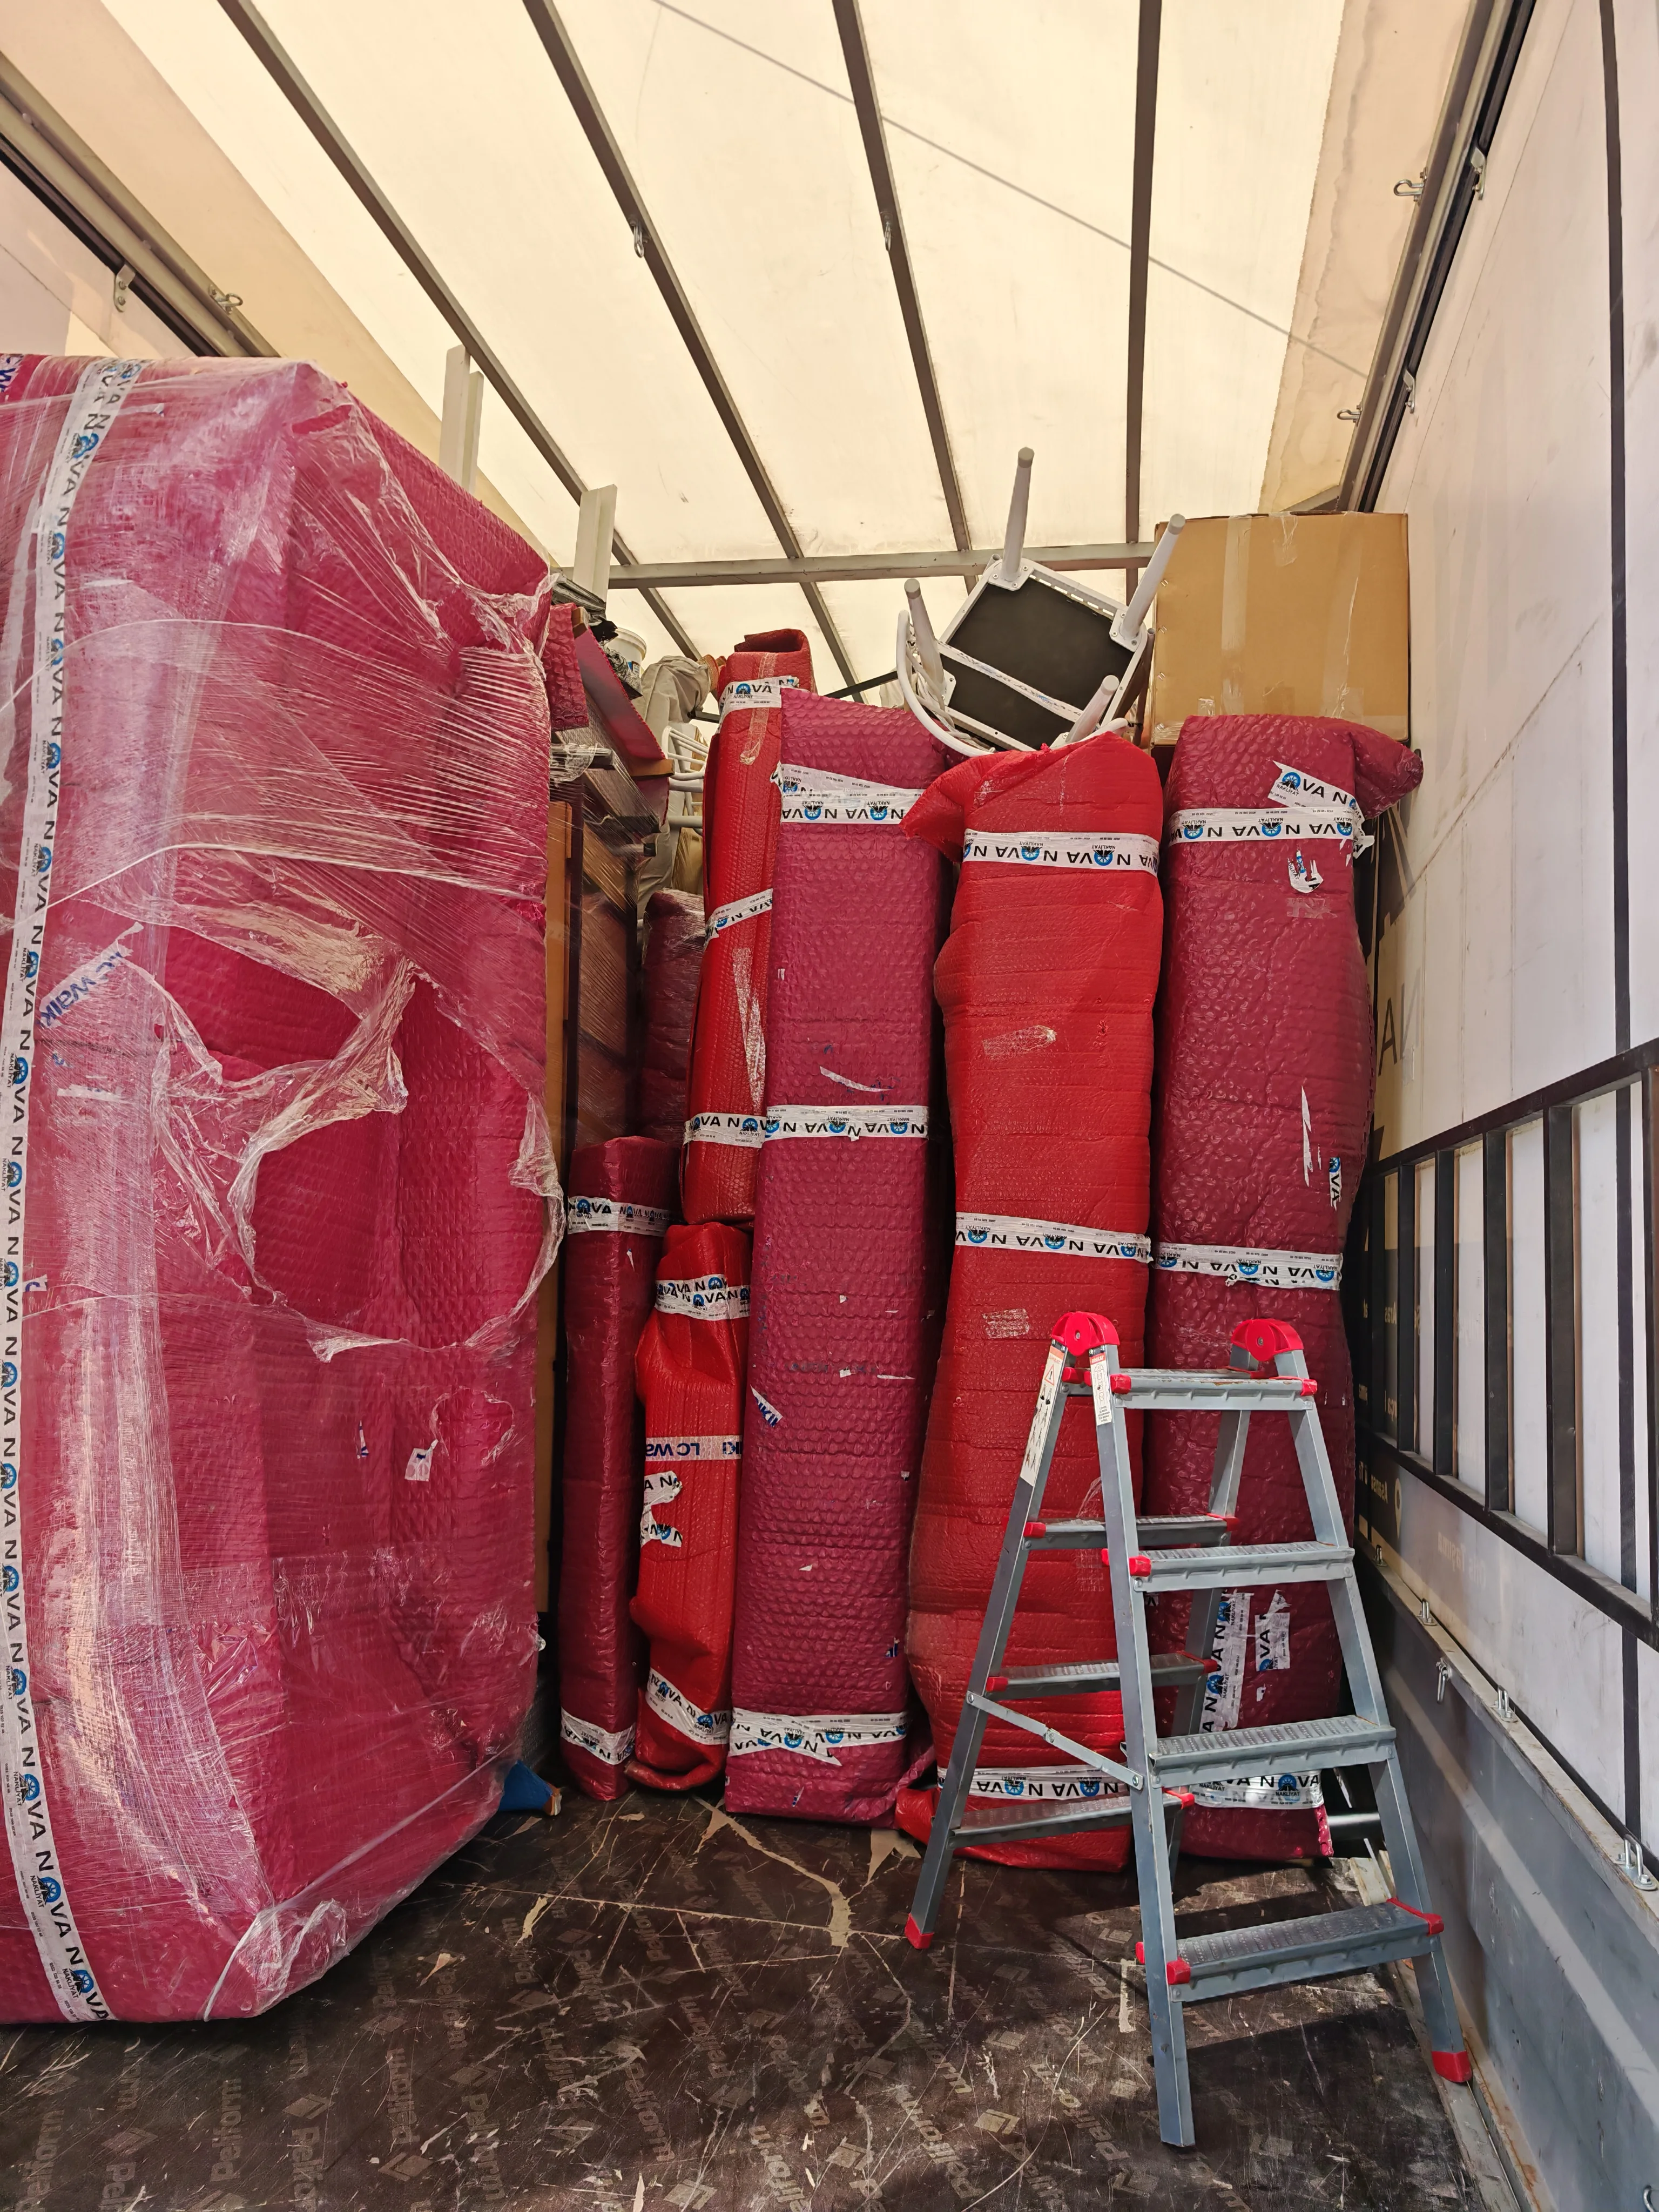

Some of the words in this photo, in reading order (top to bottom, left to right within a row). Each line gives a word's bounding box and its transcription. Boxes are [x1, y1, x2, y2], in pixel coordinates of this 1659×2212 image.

[727, 683, 772, 694] NOVA
[47, 716, 62, 808] NOVA
[781, 808, 837, 820] NOVA
[846, 809, 903, 821] NOVA
[1232, 824, 1300, 838] NOVA
[35, 820, 55, 913] NOVA
[995, 846, 1057, 862] NOVA
[1067, 852, 1130, 866] NOVA
[23, 925, 43, 1017] NOVA
[12, 1030, 31, 1123] NOVA
[864, 1121, 925, 1135] NOVA
[8, 1136, 23, 1225] NOVA
[1016, 1236, 1083, 1251] NOVA
[5, 1237, 19, 1323] NOVA
[1211, 1262, 1278, 1276] NOVA
[4, 1337, 18, 1426] NOVA
[4, 1438, 17, 1527] NOVA
[5, 1540, 21, 1630] NOVA
[10, 1643, 31, 1734] NOVA
[760, 1728, 817, 1753] NOVA
[21, 1746, 46, 1840] NOVA
[977, 1781, 1043, 1796] NOVA
[1053, 1781, 1118, 1797] NOVA
[1260, 1774, 1319, 1789] NOVA
[35, 1851, 72, 1938] NOVA
[65, 1946, 110, 2020] NOVA
